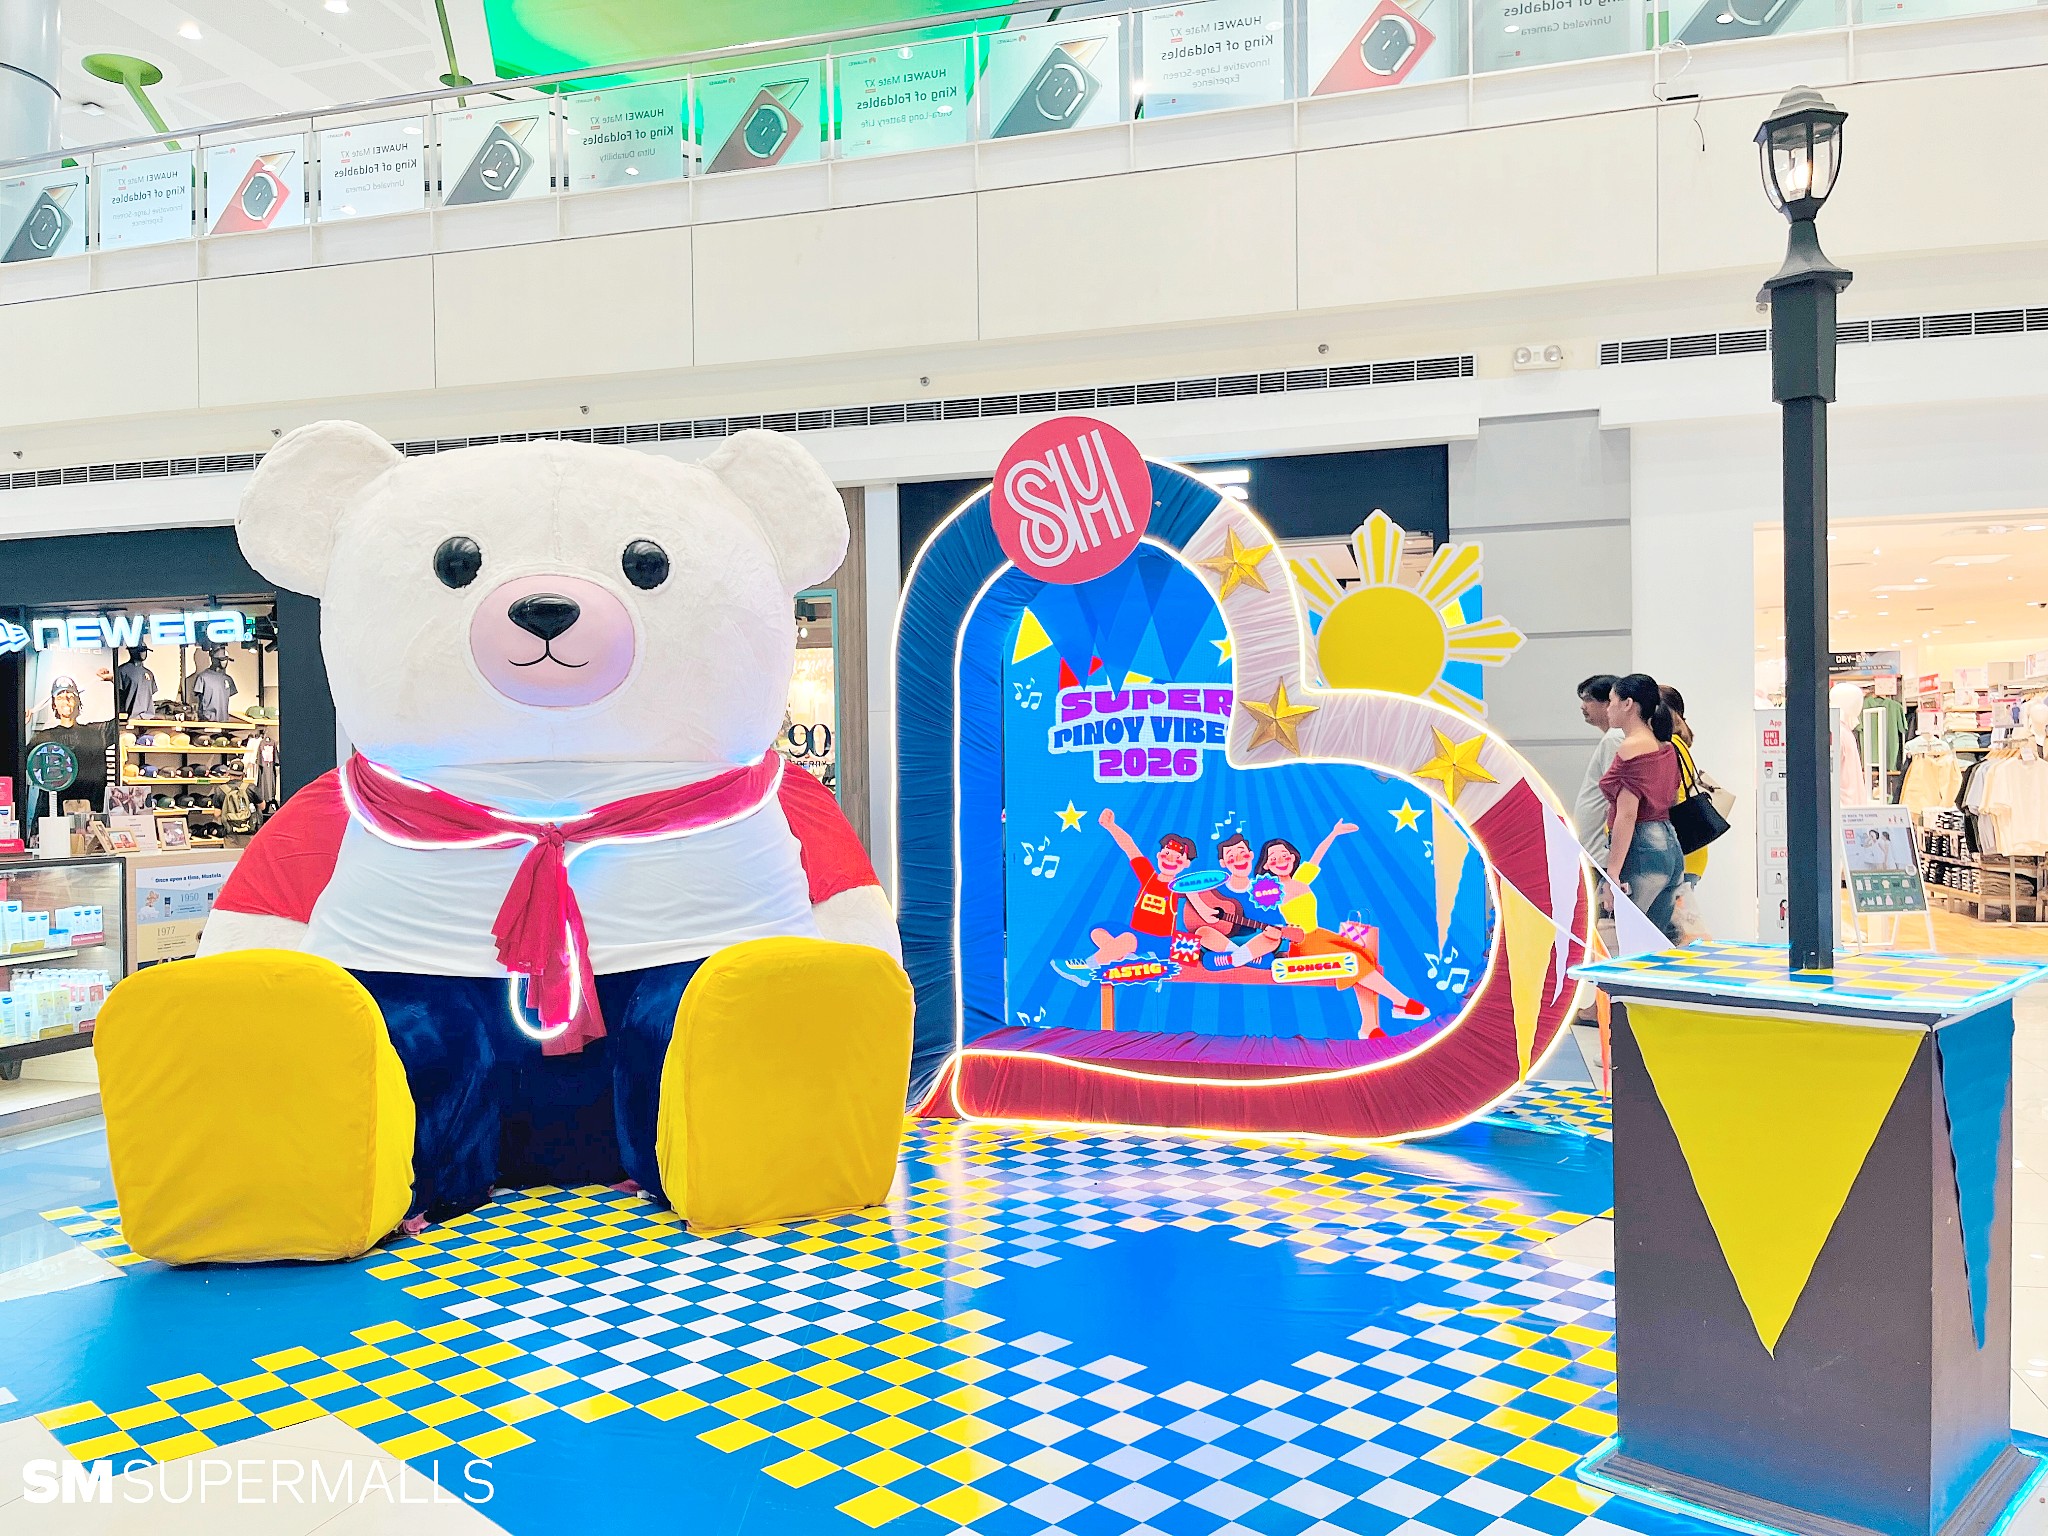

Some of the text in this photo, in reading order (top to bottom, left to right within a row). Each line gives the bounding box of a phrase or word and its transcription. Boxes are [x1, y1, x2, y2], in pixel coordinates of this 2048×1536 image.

[1061, 689, 1233, 723] SUPER
[788, 724, 831, 758] 90
[1054, 716, 1229, 748] PINOY VIBE
[1099, 748, 1197, 777] 2026
[181, 892, 199, 903] 1950
[157, 926, 176, 937] 1977
[1109, 963, 1161, 979] ASTIG
[1287, 962, 1341, 972] BONGGA
